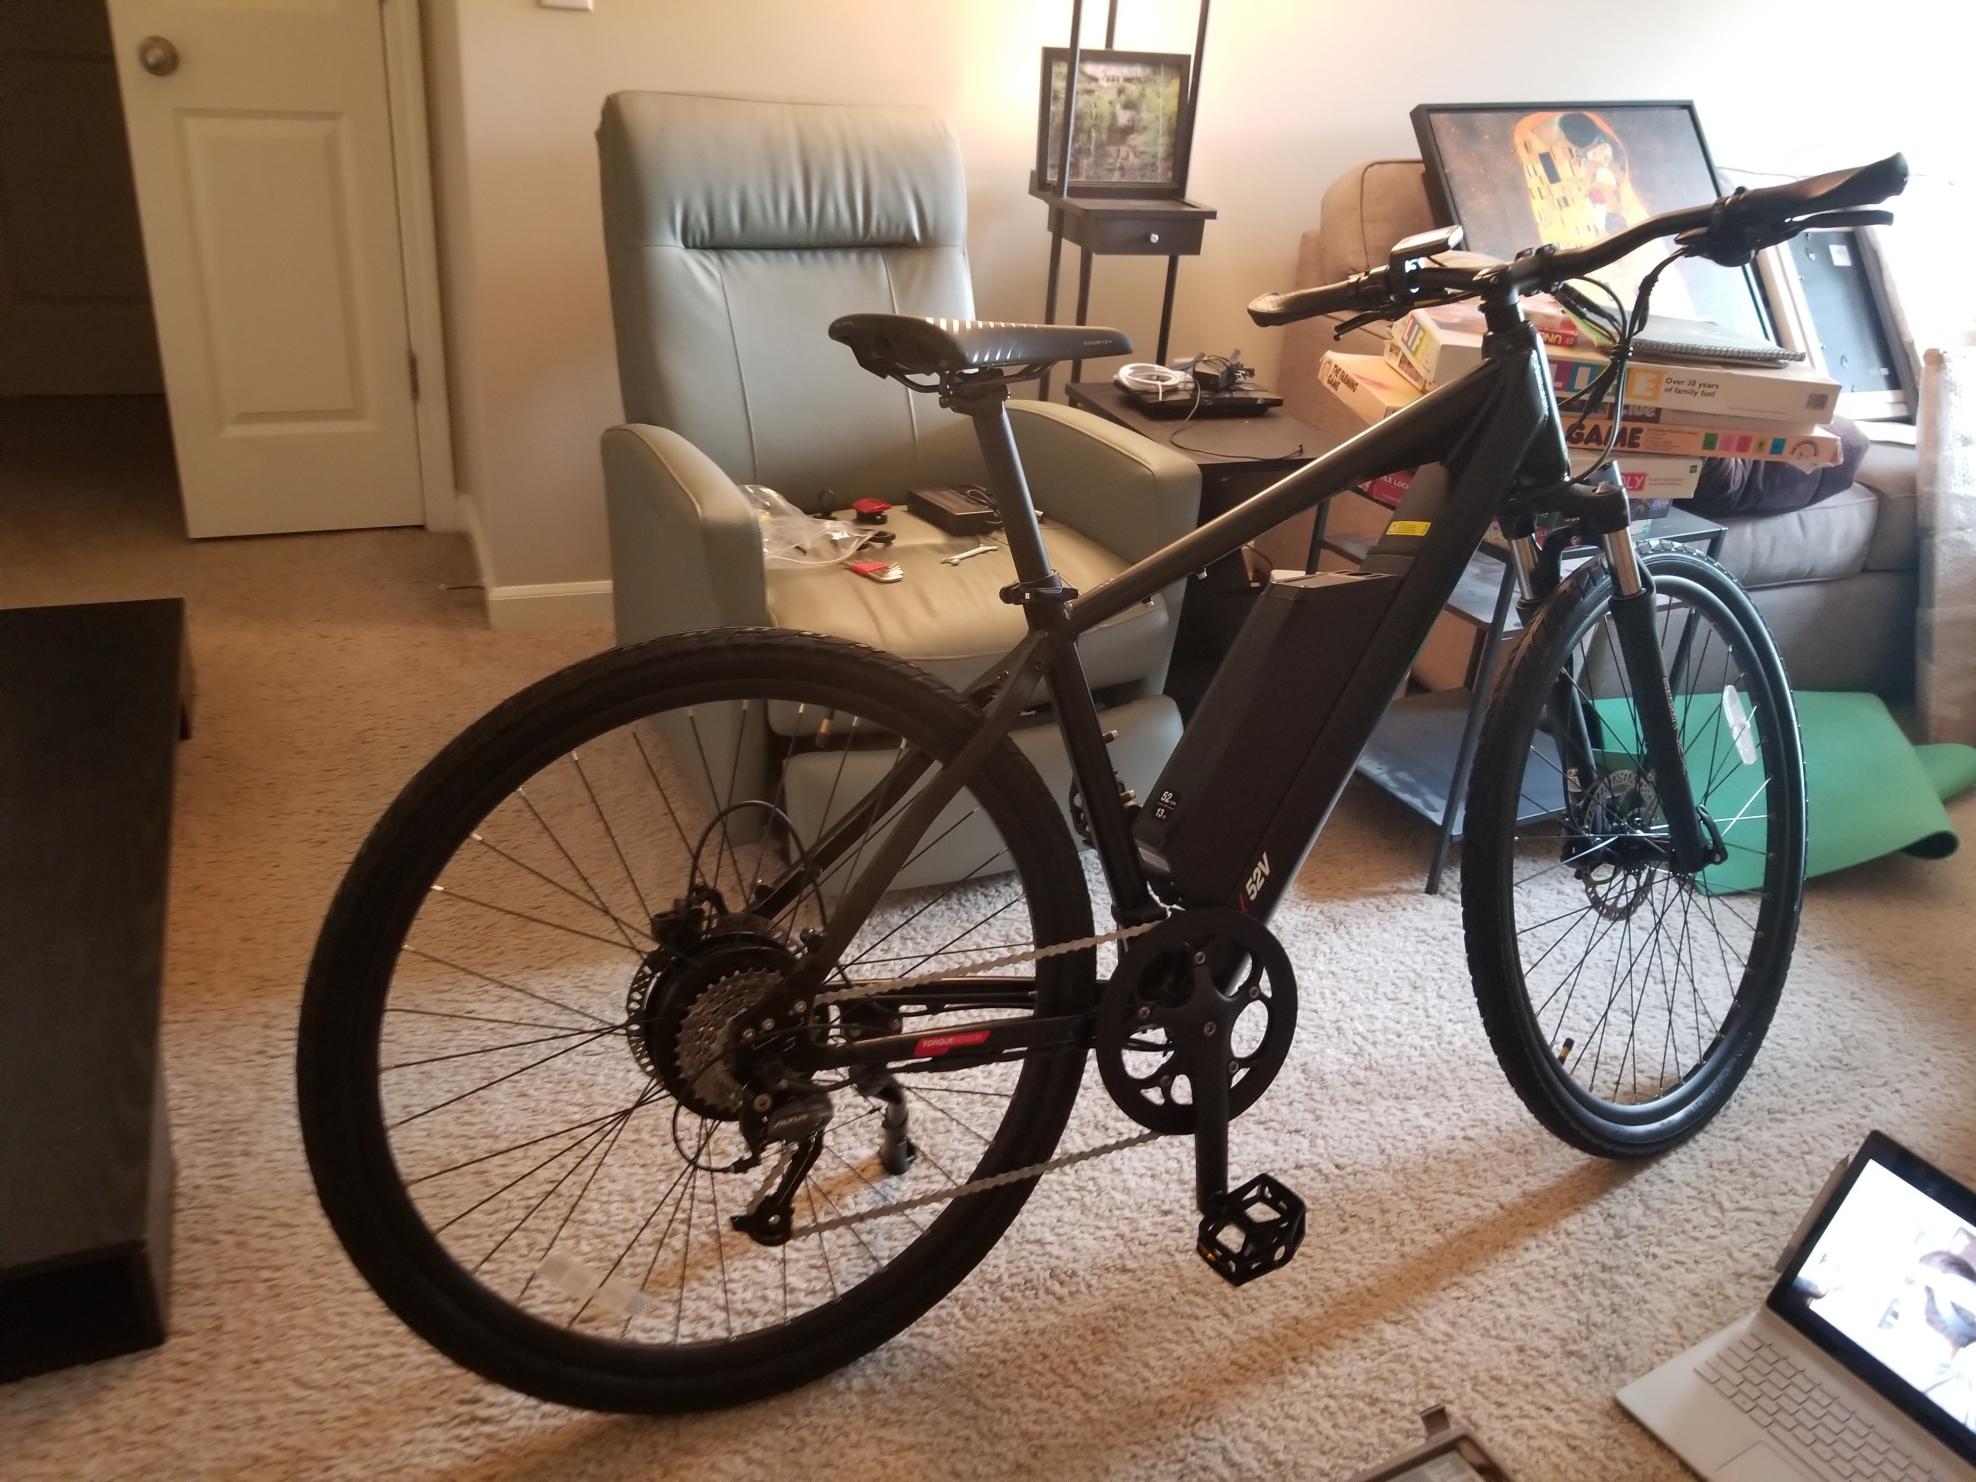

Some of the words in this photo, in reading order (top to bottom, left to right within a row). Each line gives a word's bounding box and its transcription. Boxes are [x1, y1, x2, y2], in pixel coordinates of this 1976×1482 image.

[1550, 362, 1659, 399] LIE
[1665, 377, 1686, 386] Over
[1698, 382, 1719, 390] years
[1674, 386, 1698, 398] family
[1700, 389, 1716, 398] fun!
[1565, 421, 1644, 448] GAME
[1160, 790, 1173, 803] 52
[1155, 807, 1165, 818] 13
[1245, 852, 1271, 901] 52V
[921, 1036, 954, 1048] TORQUE
